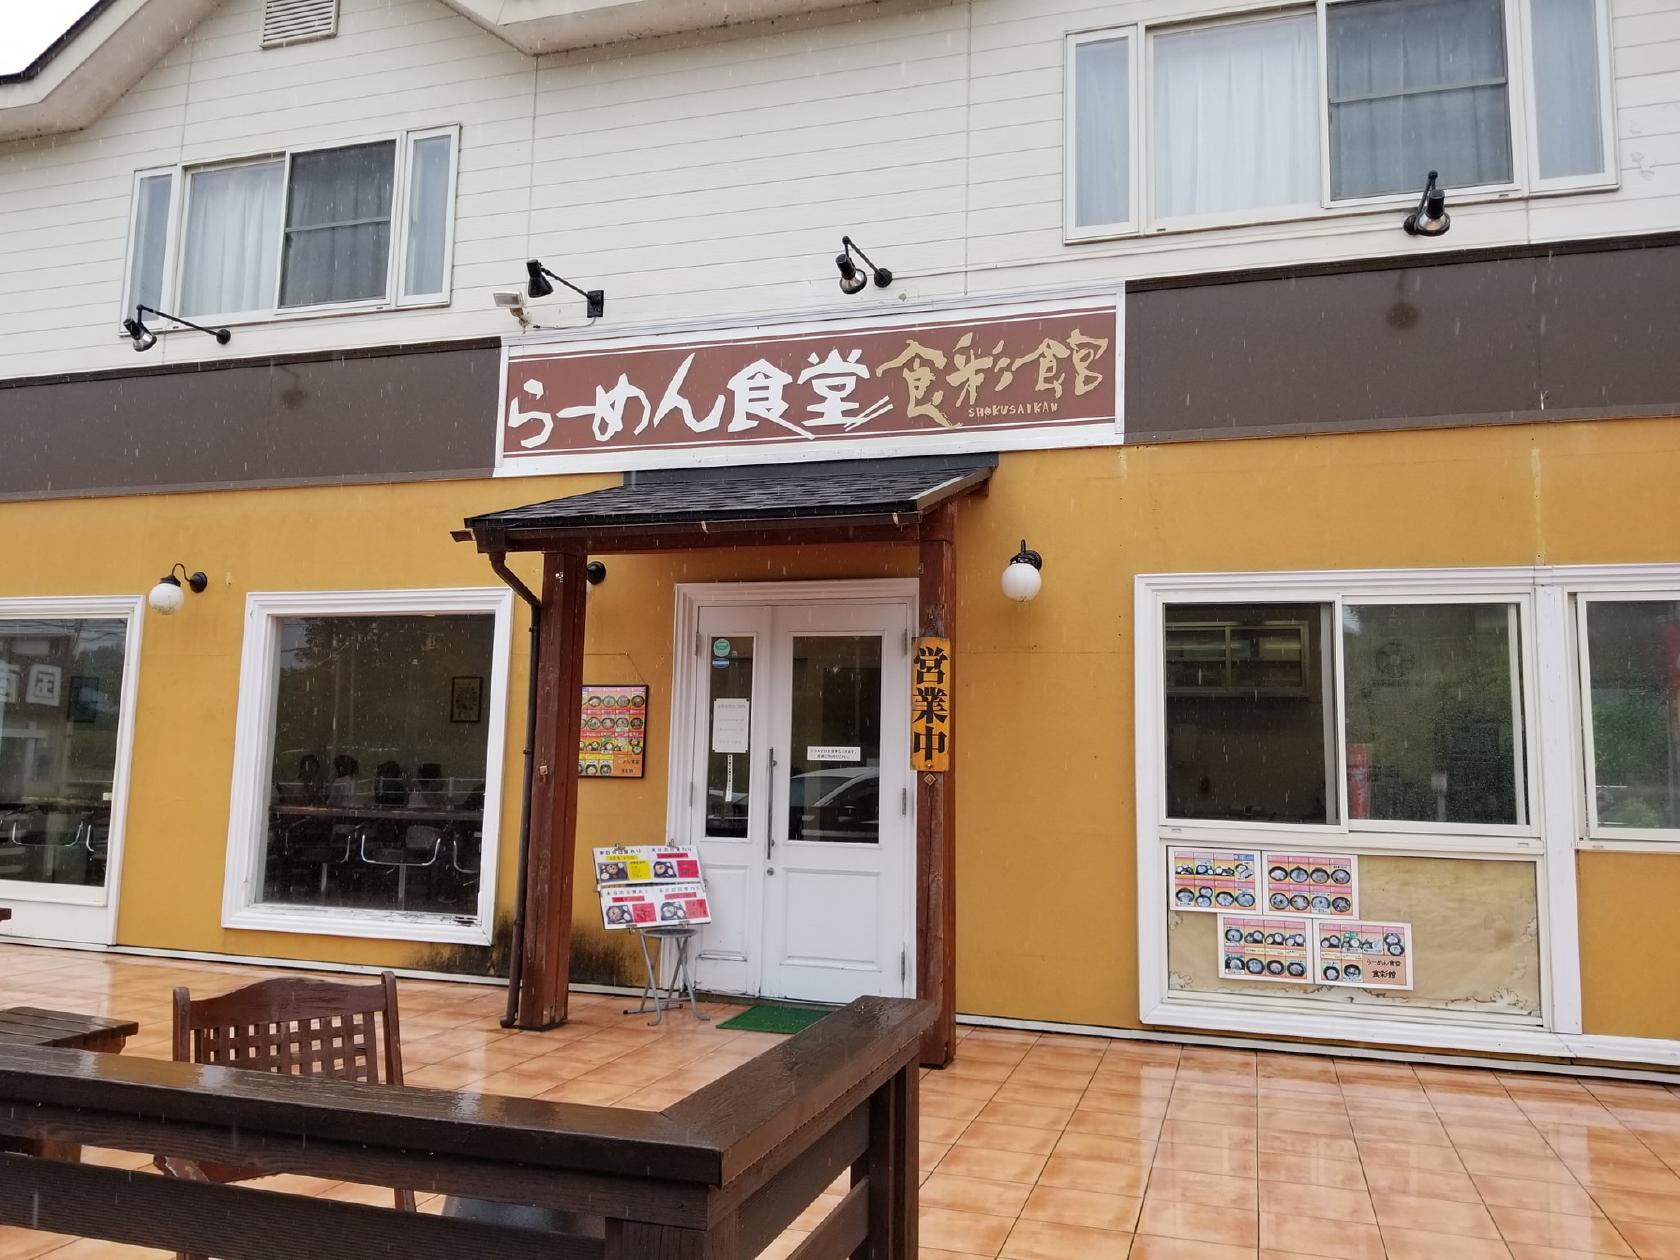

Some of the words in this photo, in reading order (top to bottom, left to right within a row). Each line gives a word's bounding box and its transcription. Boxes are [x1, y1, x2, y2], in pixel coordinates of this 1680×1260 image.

[507, 347, 895, 449] らーめん食堂
[875, 328, 1109, 430] 食彩館
[967, 401, 1059, 418] SHOKUSAIKAN
[912, 645, 950, 763] 営業中
